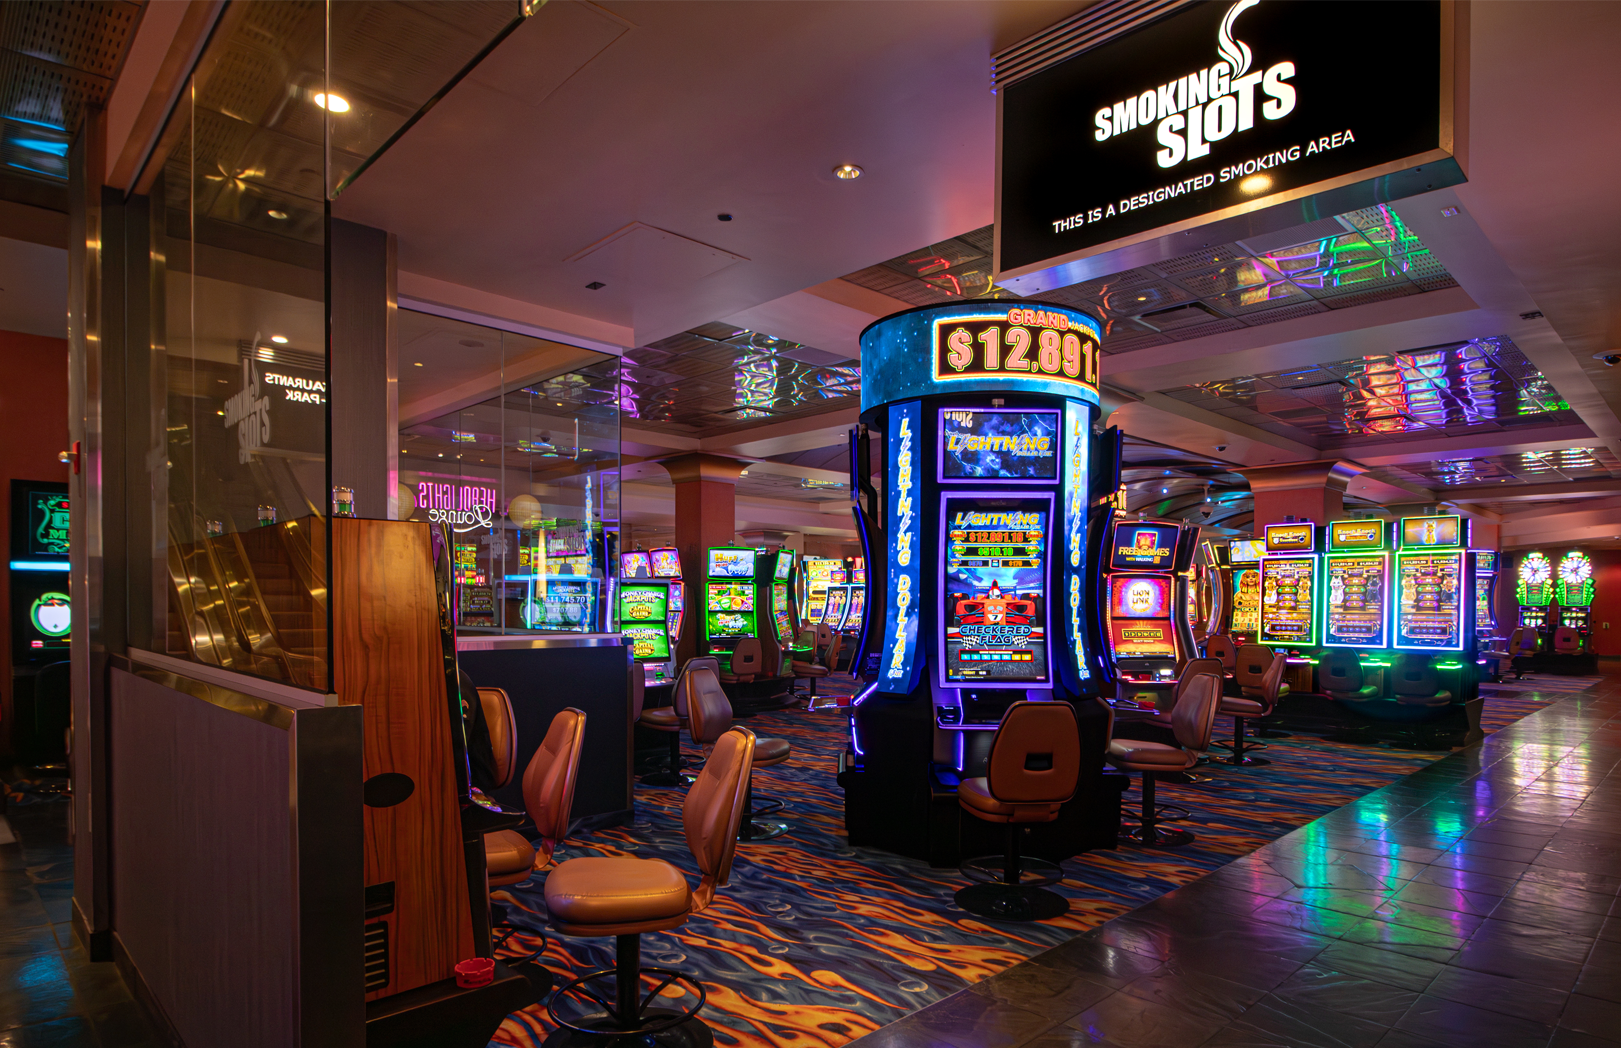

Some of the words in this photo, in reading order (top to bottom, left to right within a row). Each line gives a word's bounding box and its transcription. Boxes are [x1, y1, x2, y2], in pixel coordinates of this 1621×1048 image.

[1094, 61, 1231, 142] SMOKING
[1156, 61, 1297, 169] SLOTS
[1053, 213, 1084, 234] THIS
[1088, 208, 1102, 224] IS
[1105, 203, 1116, 218] A
[1120, 173, 1215, 214] DESIGNATED
[1219, 146, 1301, 183] SMOKING
[1306, 129, 1355, 156] AREA
[1008, 308, 1069, 331] GRAND
[947, 433, 1050, 455] LIGHTNING
[897, 417, 912, 567] LIGHTNING
[955, 511, 1040, 529] LIGHTNING
[969, 532, 1024, 543] $12,891.18
[891, 574, 911, 669] DOLLAR
[959, 625, 1032, 636] CHECKERED
[979, 635, 1013, 646] FLAG
[1069, 574, 1087, 670] DOLLAR
